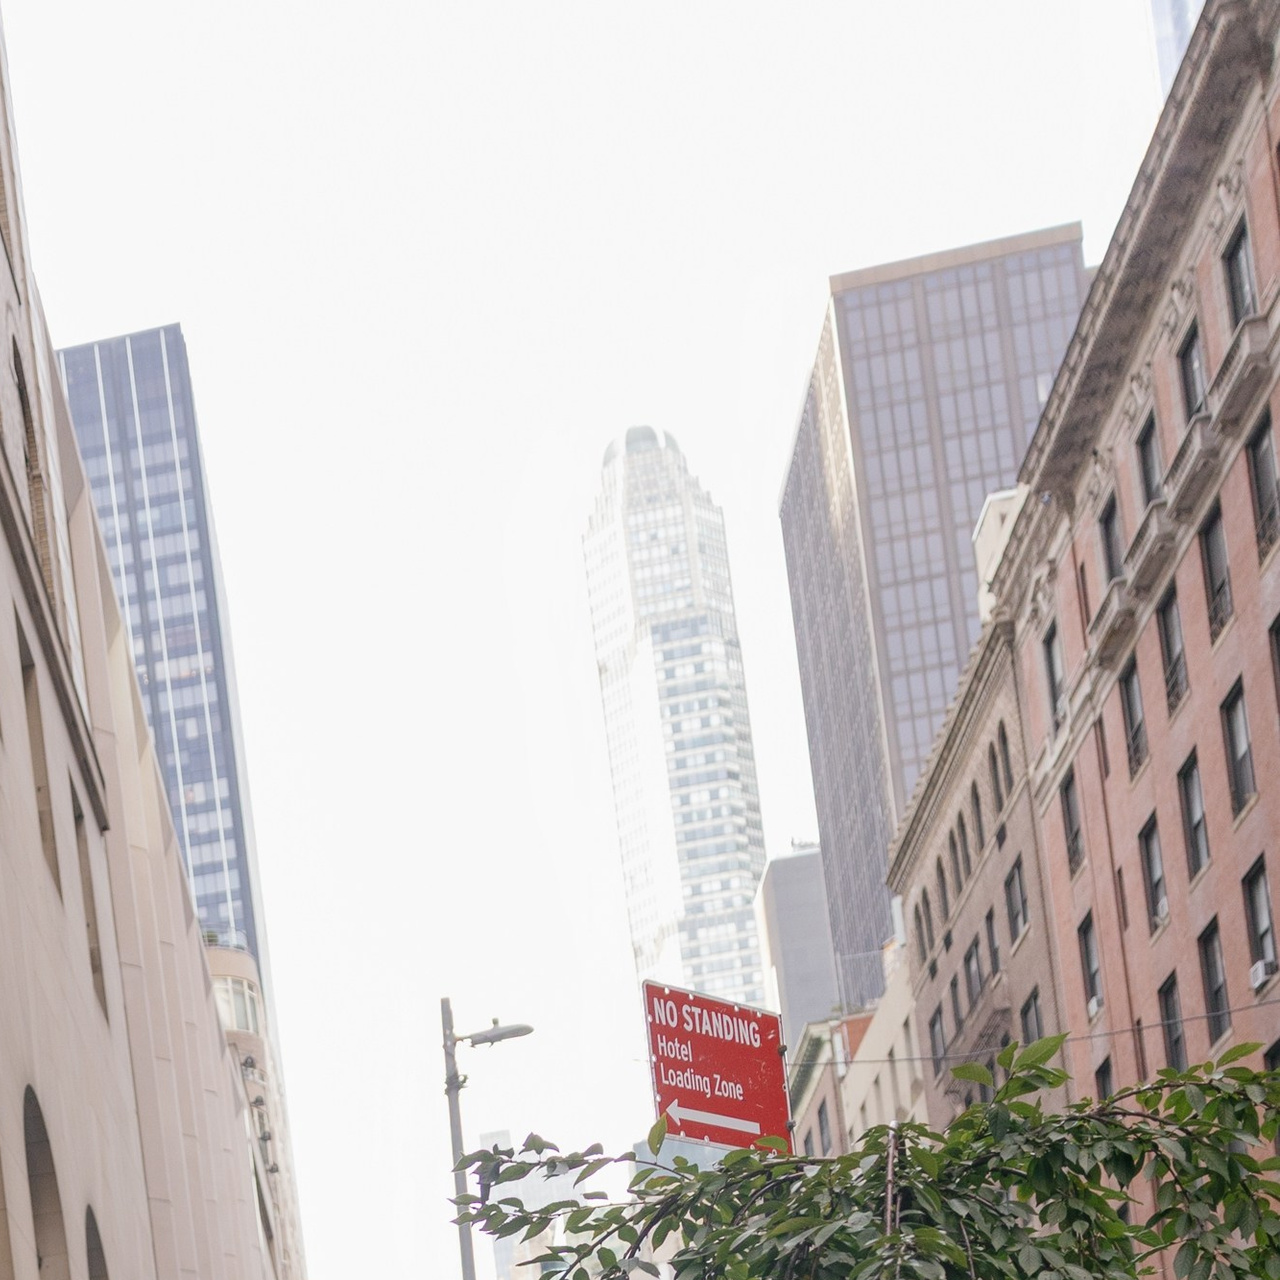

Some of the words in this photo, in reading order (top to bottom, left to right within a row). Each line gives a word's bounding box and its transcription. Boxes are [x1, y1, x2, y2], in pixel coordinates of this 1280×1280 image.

[653, 997, 678, 1028] NO
[682, 1004, 761, 1048] STANDING
[657, 1034, 693, 1062] Hotel
[660, 1062, 711, 1098] Loading
[713, 1073, 744, 1100] Zone
